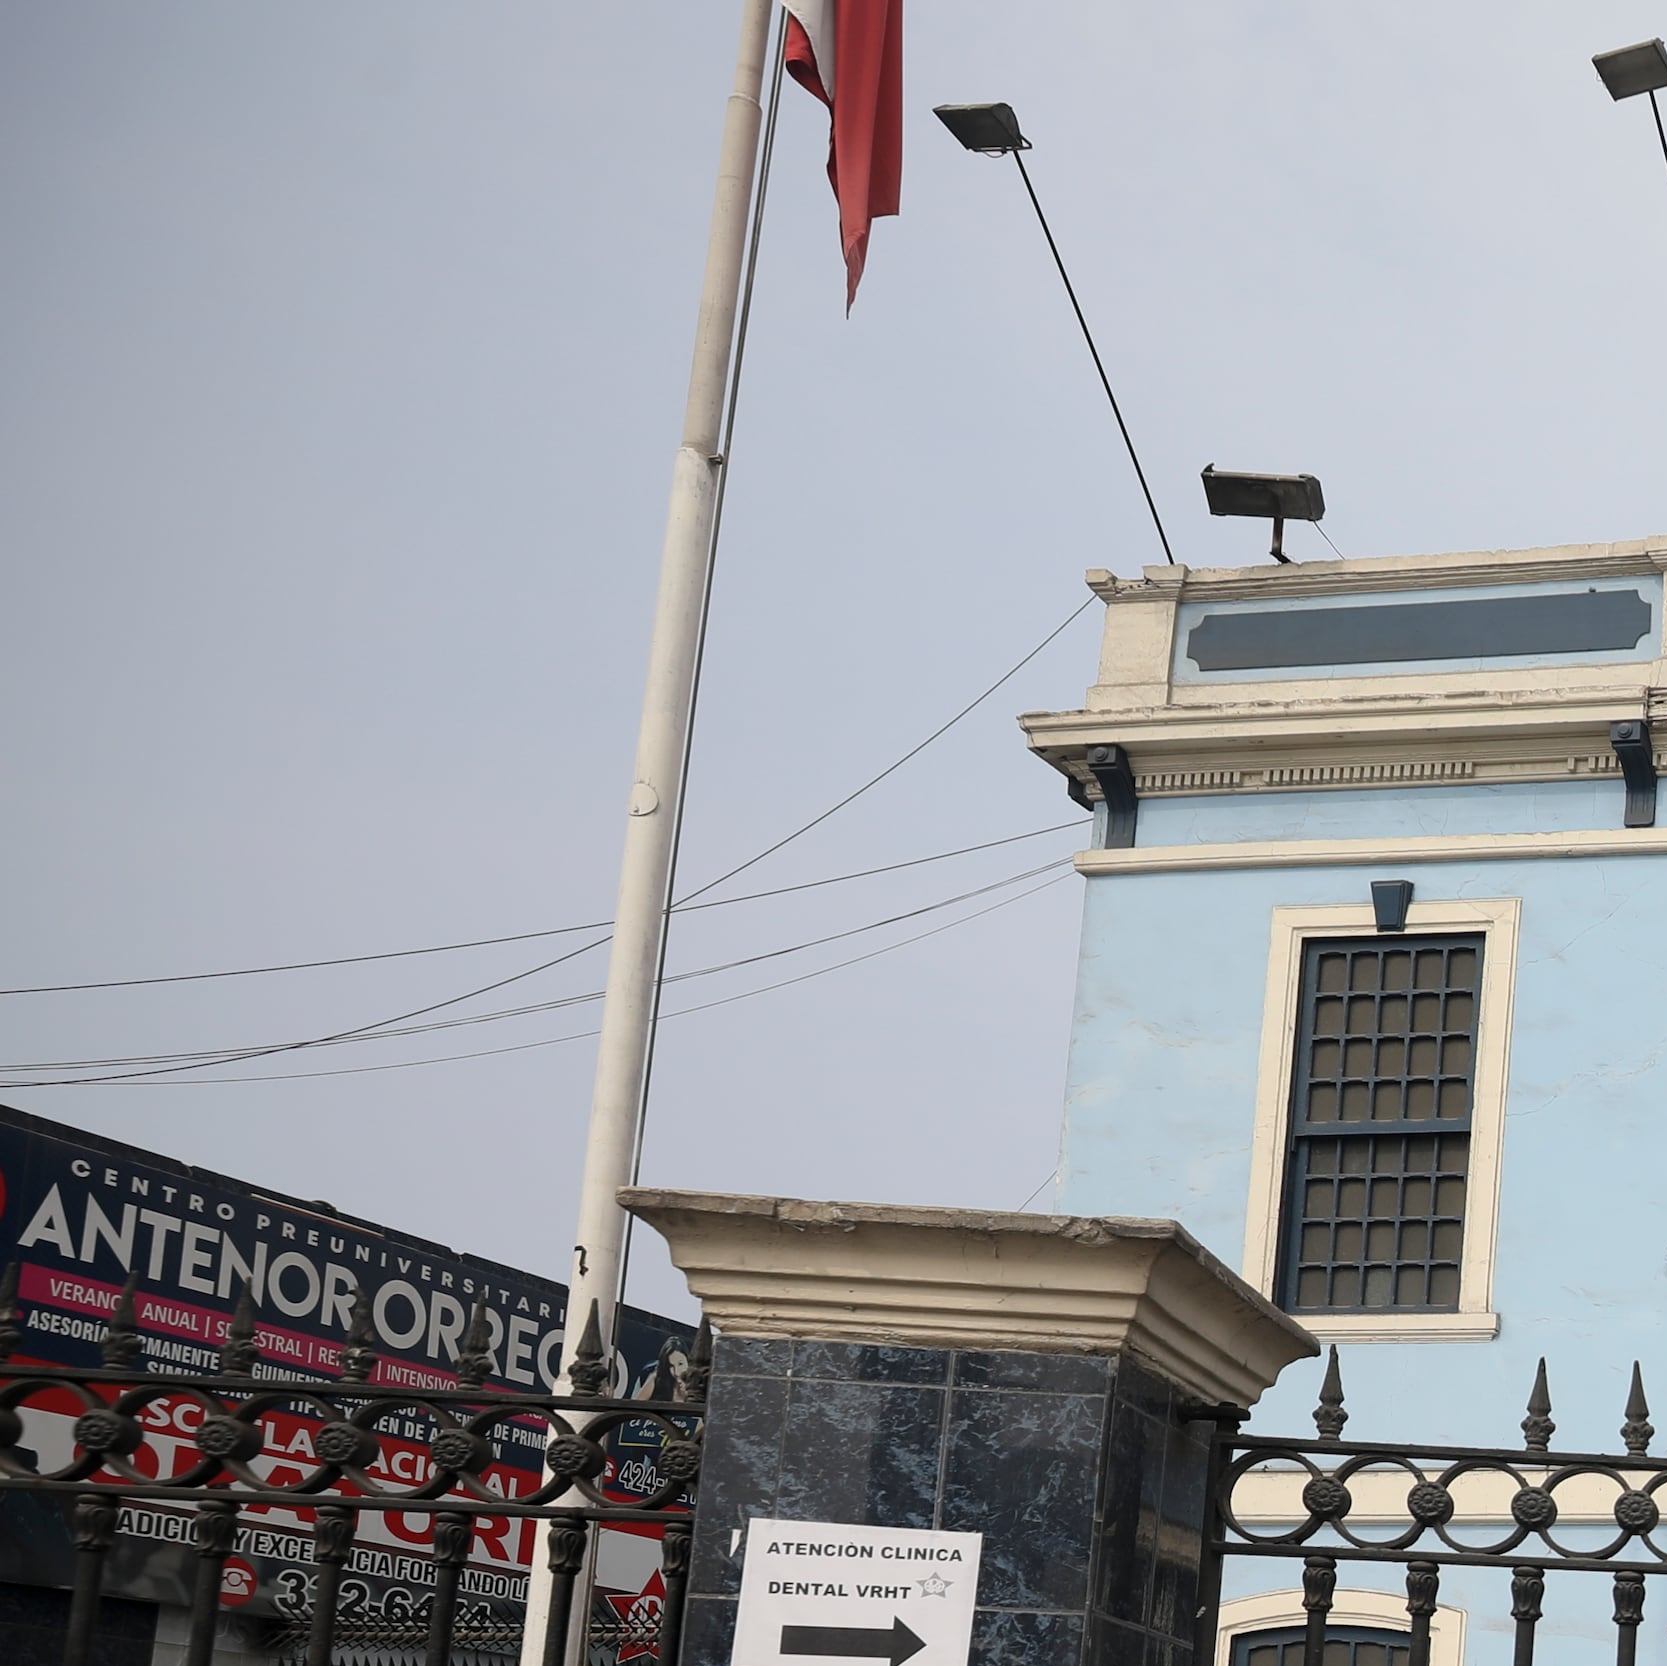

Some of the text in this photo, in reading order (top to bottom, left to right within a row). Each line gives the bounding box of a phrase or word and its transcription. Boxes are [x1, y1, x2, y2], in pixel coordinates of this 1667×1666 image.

[17, 1182, 358, 1332] ANTENOR
[71, 1159, 564, 1323] CENTRO PREUNIVERSITARI
[141, 1302, 199, 1332] ANUAL
[215, 1319, 303, 1358] SEESTRAL
[404, 1420, 425, 1441] DE
[494, 1423, 548, 1451] DE PRIME
[880, 1545, 964, 1563] CLINICA
[395, 1556, 509, 1600] FORANDO
[767, 1580, 849, 1598] DENTAL
[855, 1584, 913, 1600] VRHT
